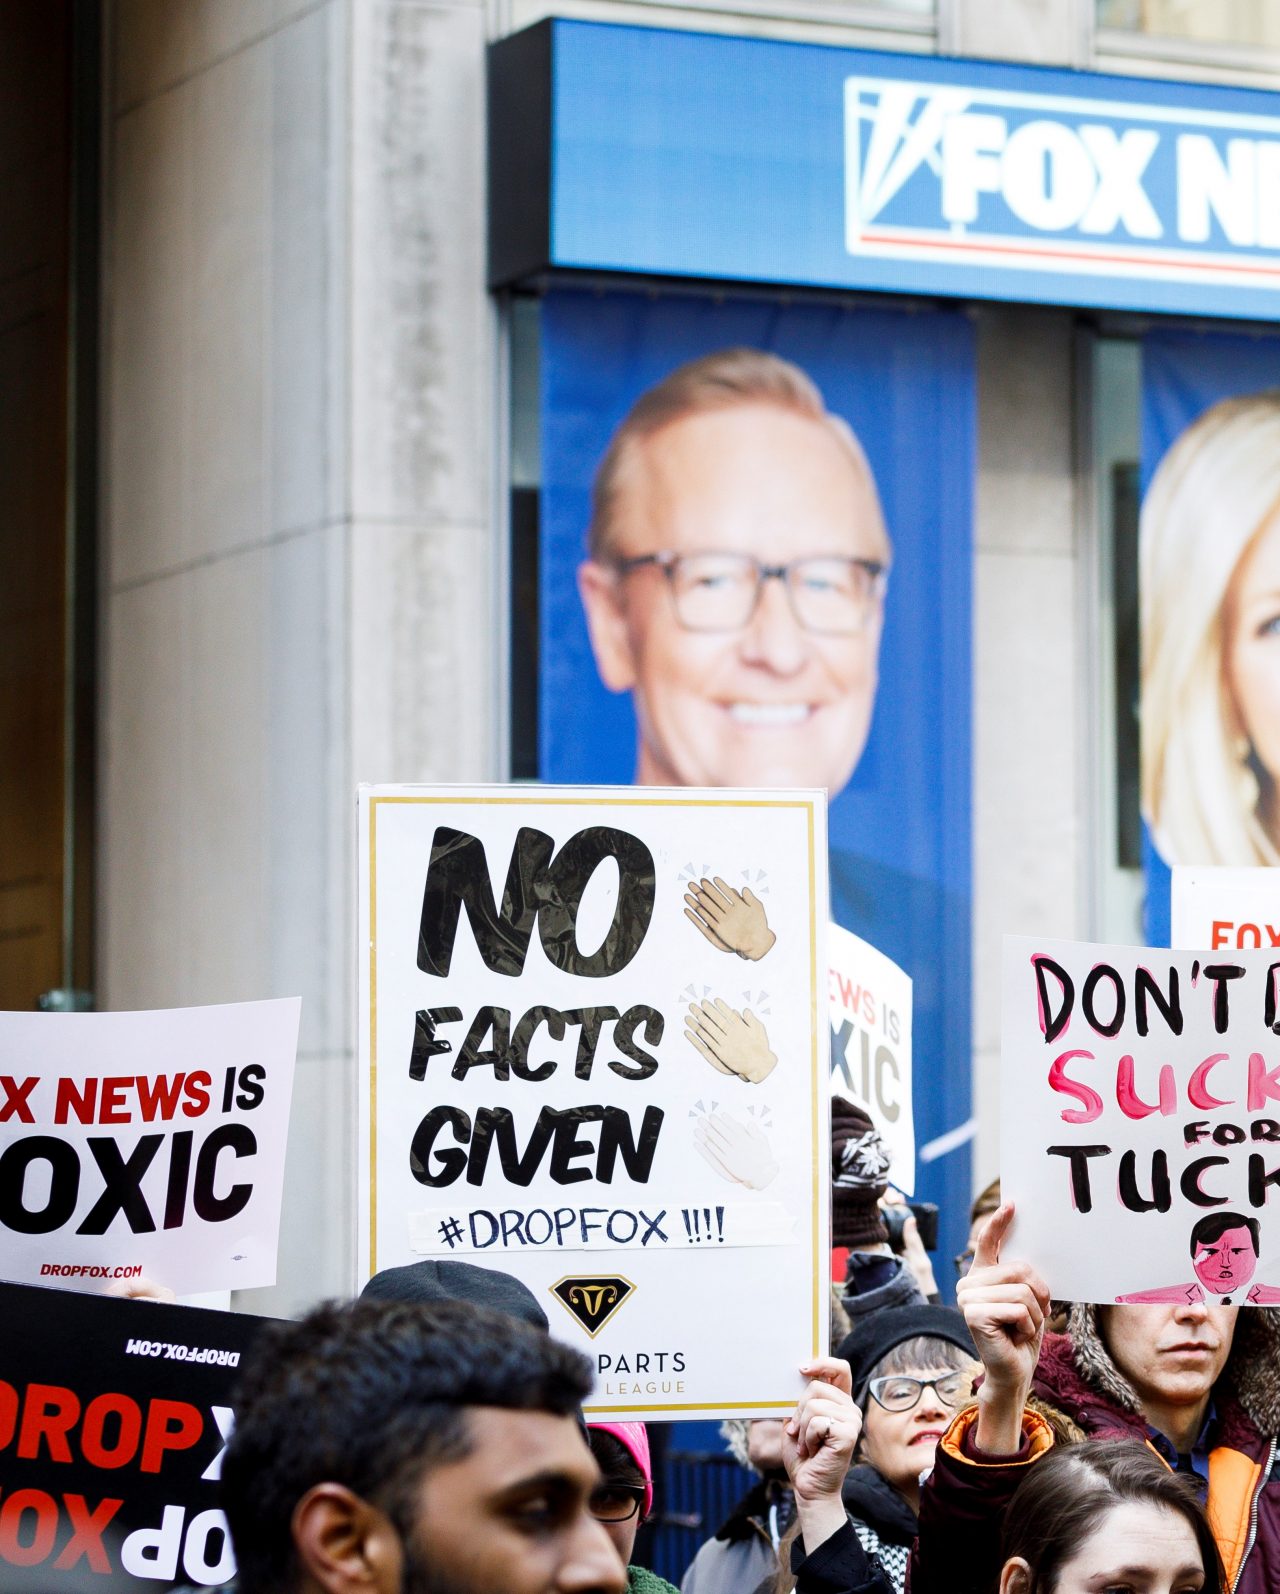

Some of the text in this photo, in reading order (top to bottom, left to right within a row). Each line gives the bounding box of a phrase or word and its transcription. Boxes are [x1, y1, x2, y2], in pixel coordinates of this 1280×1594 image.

[942, 112, 1164, 239] FOX
[416, 826, 656, 979] NO
[883, 1002, 900, 1046] IS
[1030, 952, 1246, 1045] DON'T
[408, 1005, 665, 1083] FACTS
[831, 1018, 900, 1124] XIC
[54, 1070, 212, 1124] NEWS
[222, 1063, 266, 1113] IS
[409, 1105, 664, 1188] GIVEN
[438, 1208, 668, 1249] #DROPFOX
[40, 1264, 142, 1279] DROPFOX.COM
[126, 1339, 240, 1367] DROPFOX.COM
[598, 1352, 686, 1374] PARTS
[606, 1381, 686, 1395] LEAGUE
[0, 1486, 124, 1575] OX
